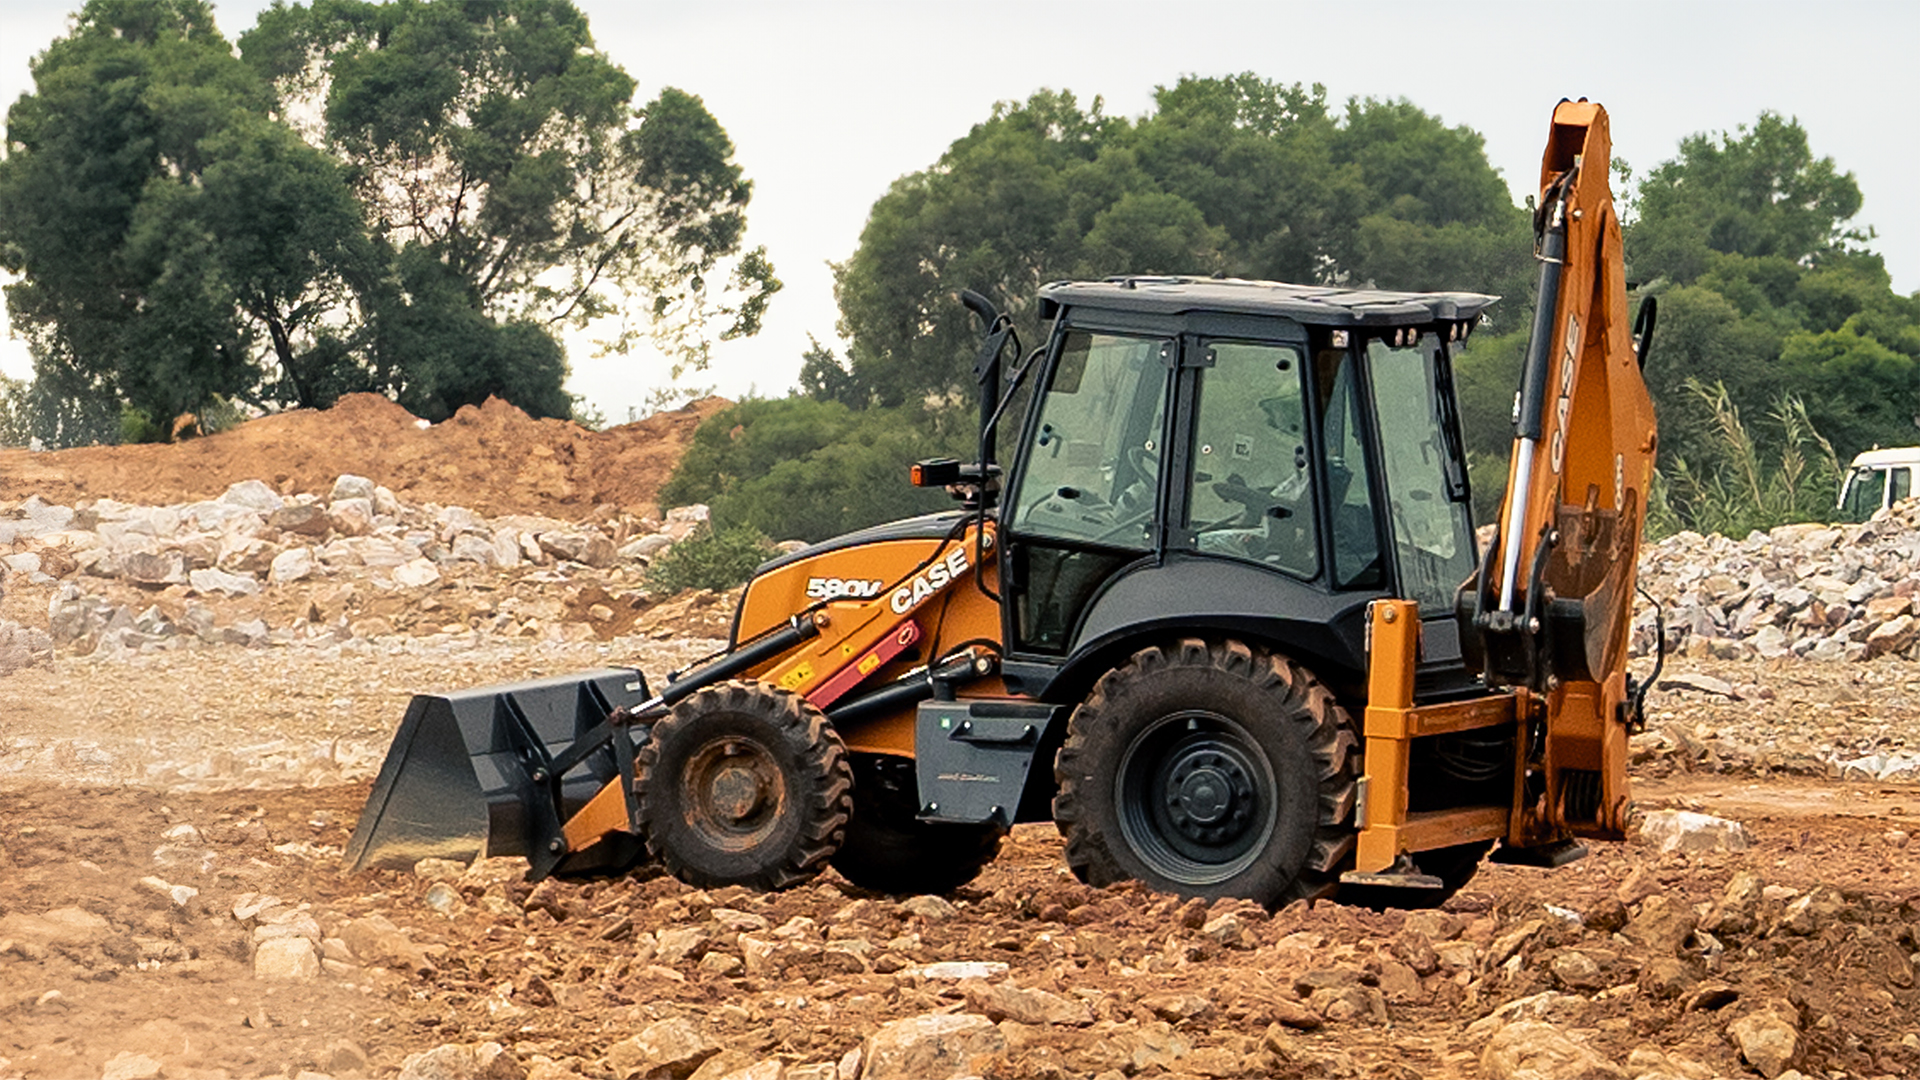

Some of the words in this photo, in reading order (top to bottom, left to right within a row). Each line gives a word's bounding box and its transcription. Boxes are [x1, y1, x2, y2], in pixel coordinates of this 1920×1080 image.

[1552, 313, 1579, 473] CASE
[806, 578, 883, 598] 580V
[891, 548, 969, 613] CASE
